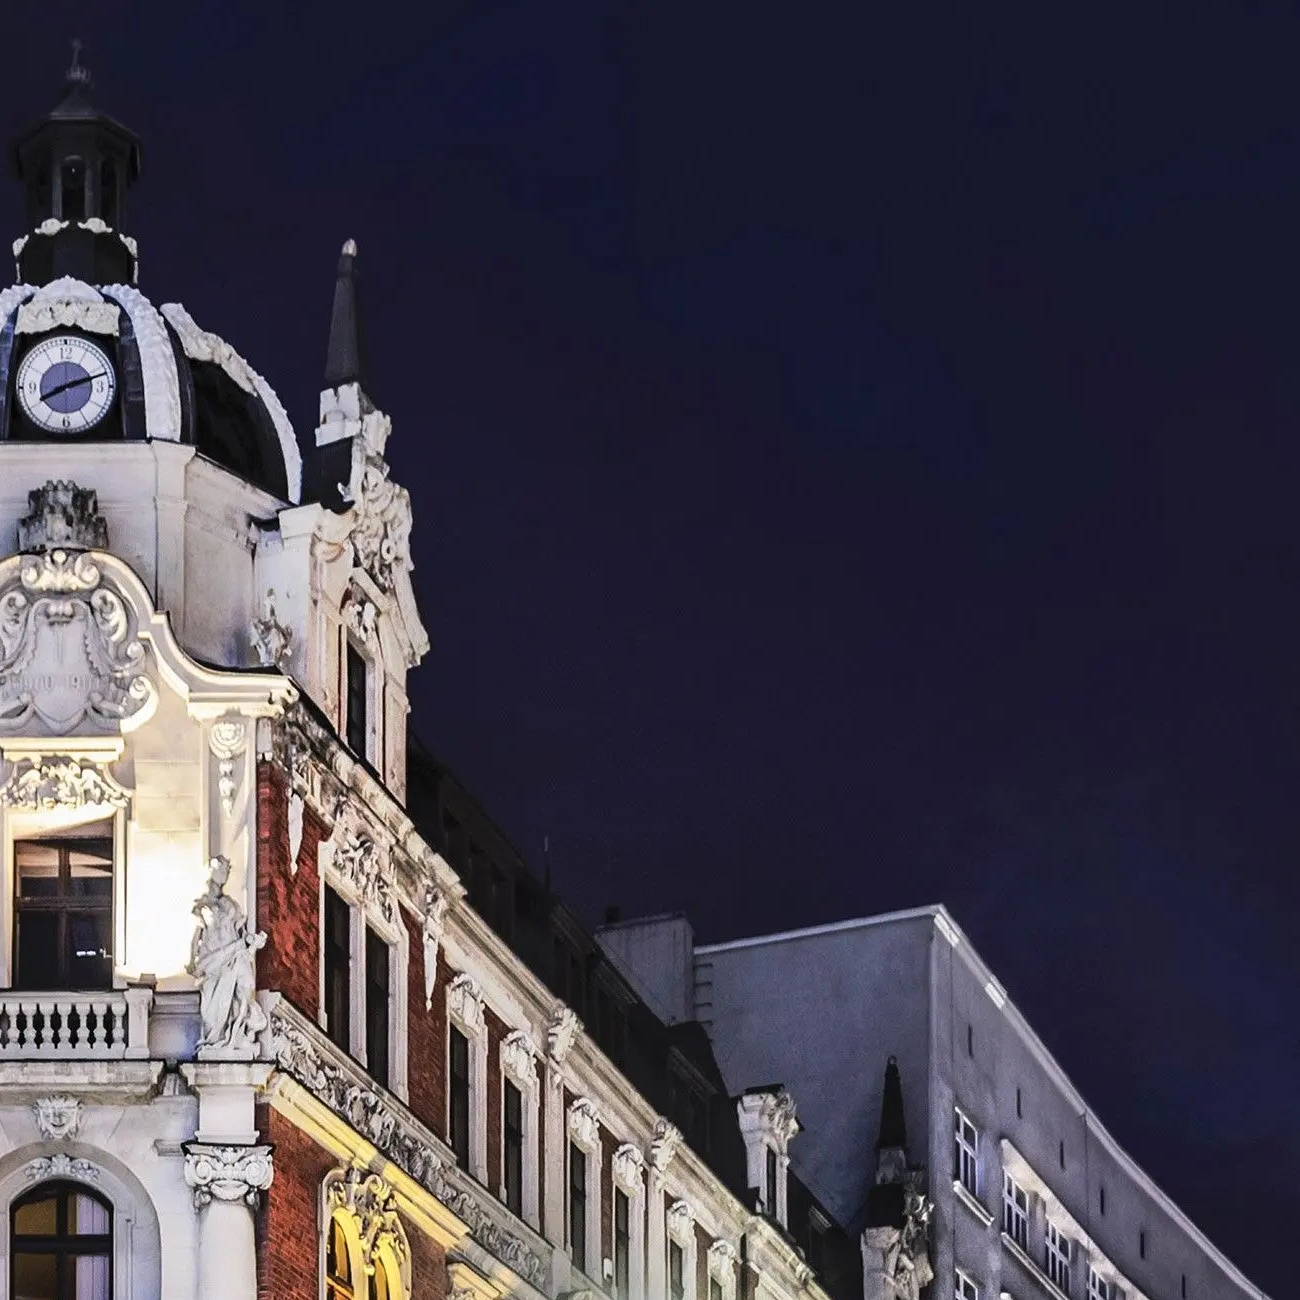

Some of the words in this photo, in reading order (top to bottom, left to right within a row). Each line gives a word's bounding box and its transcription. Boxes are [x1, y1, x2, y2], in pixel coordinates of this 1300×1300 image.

[60, 347, 73, 360] 12
[28, 382, 37, 394] 9
[96, 381, 104, 393] 3
[62, 415, 71, 428] 6
